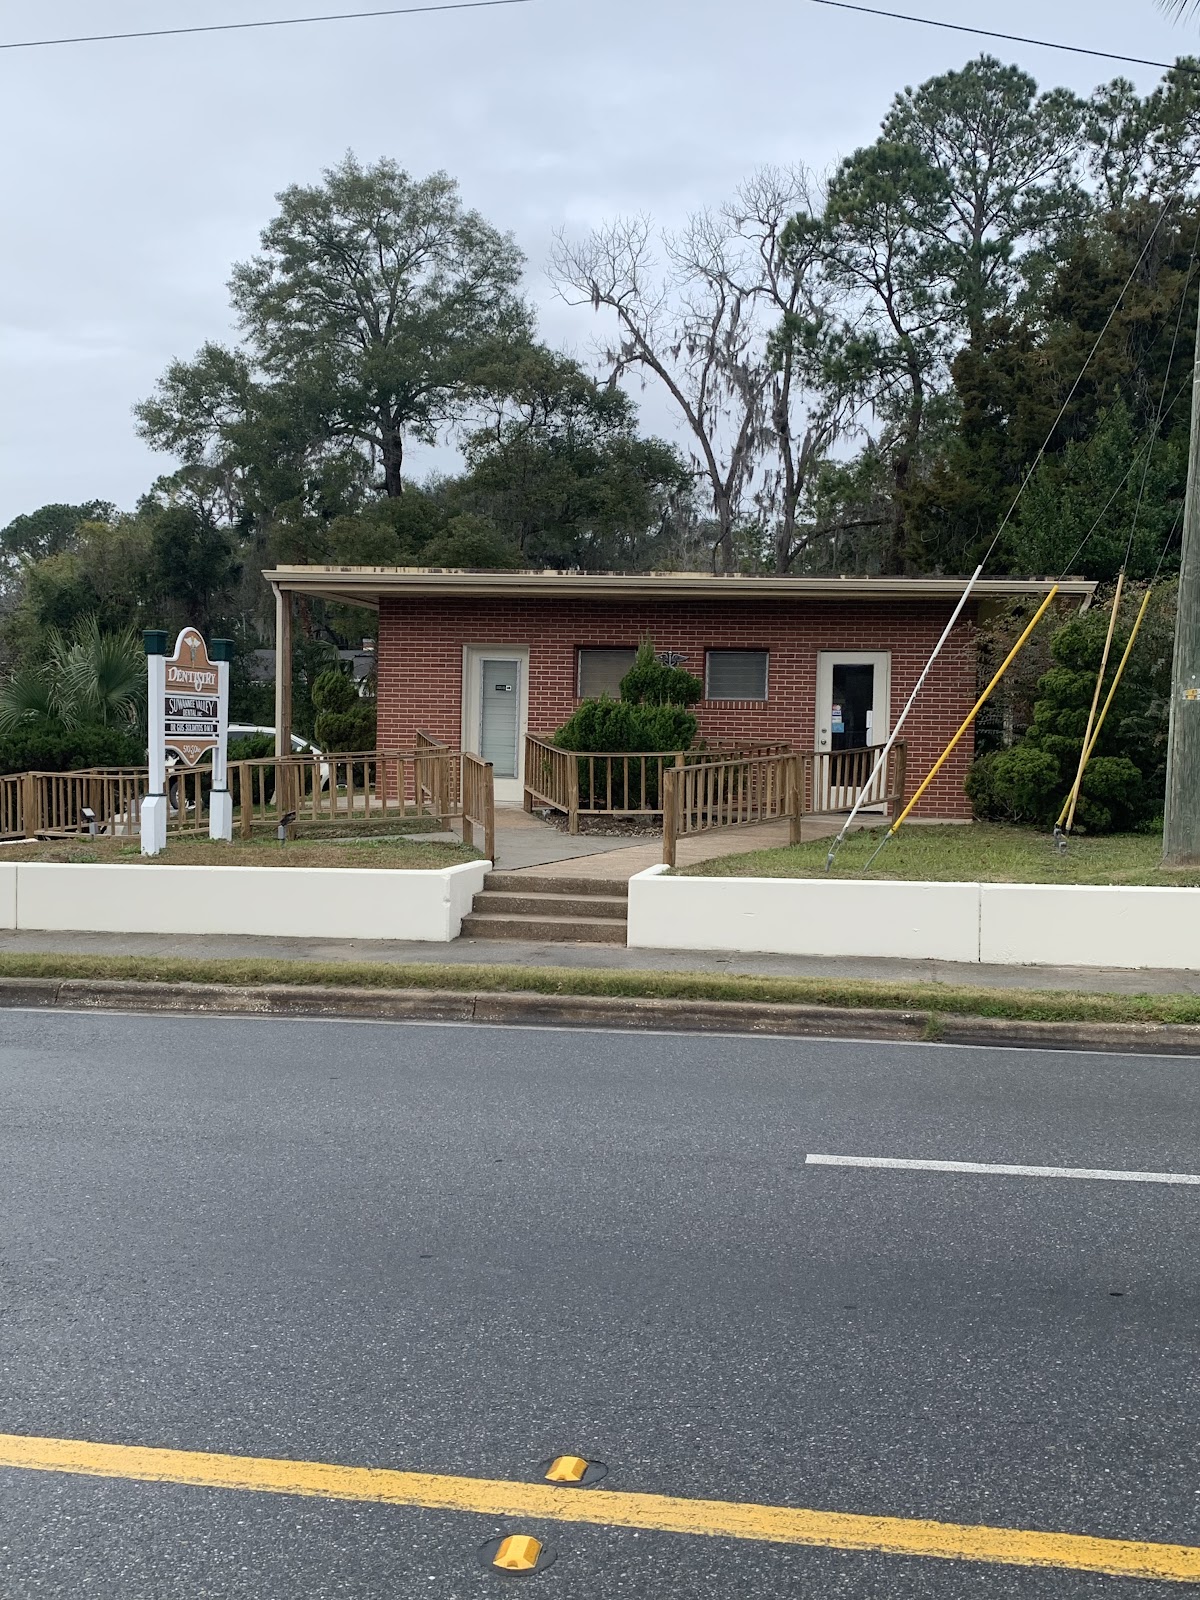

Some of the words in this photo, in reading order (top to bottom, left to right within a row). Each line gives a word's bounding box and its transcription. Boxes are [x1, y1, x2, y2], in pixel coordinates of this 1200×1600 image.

[168, 667, 216, 691] DENTISTRY
[169, 698, 196, 714] SUWANNEE
[195, 700, 214, 716] VALLEY
[183, 709, 196, 717] DENTAL
